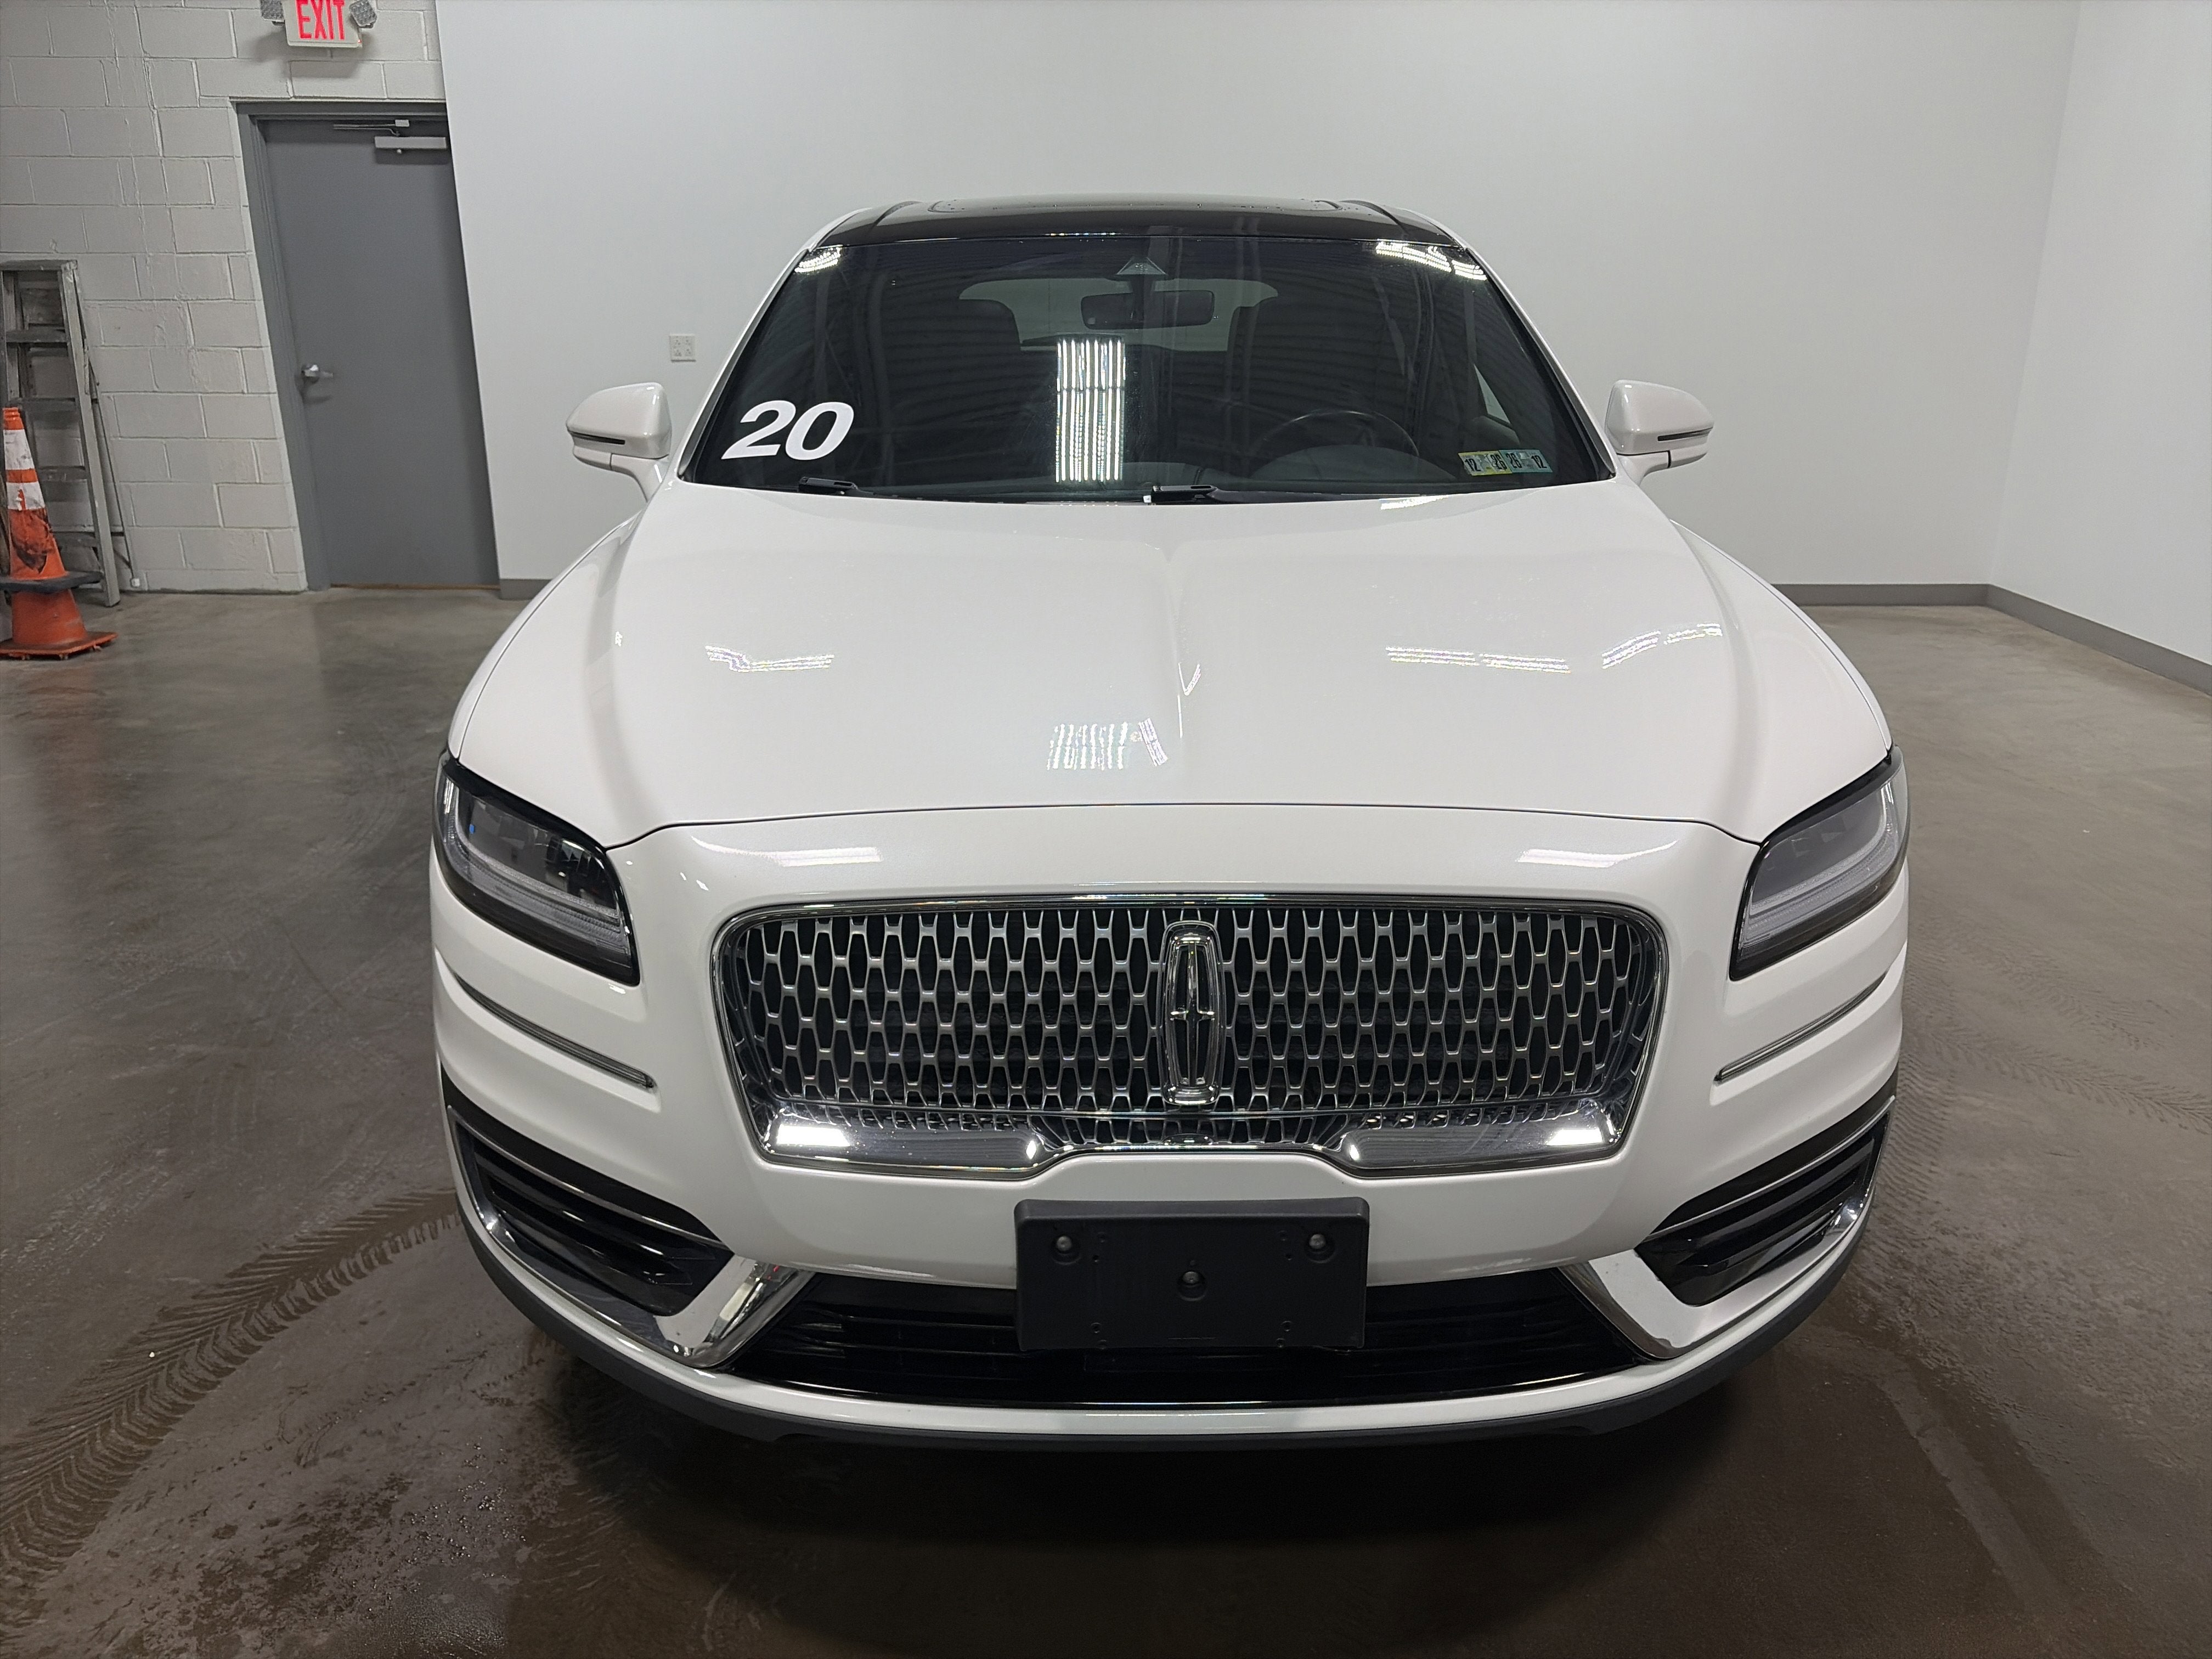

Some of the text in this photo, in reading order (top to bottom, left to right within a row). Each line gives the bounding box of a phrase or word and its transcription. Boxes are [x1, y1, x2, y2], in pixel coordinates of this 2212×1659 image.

[295, 0, 345, 40] EXIT
[721, 400, 854, 460] 20
[1464, 458, 1481, 472] 12
[1531, 455, 1548, 469] 12
